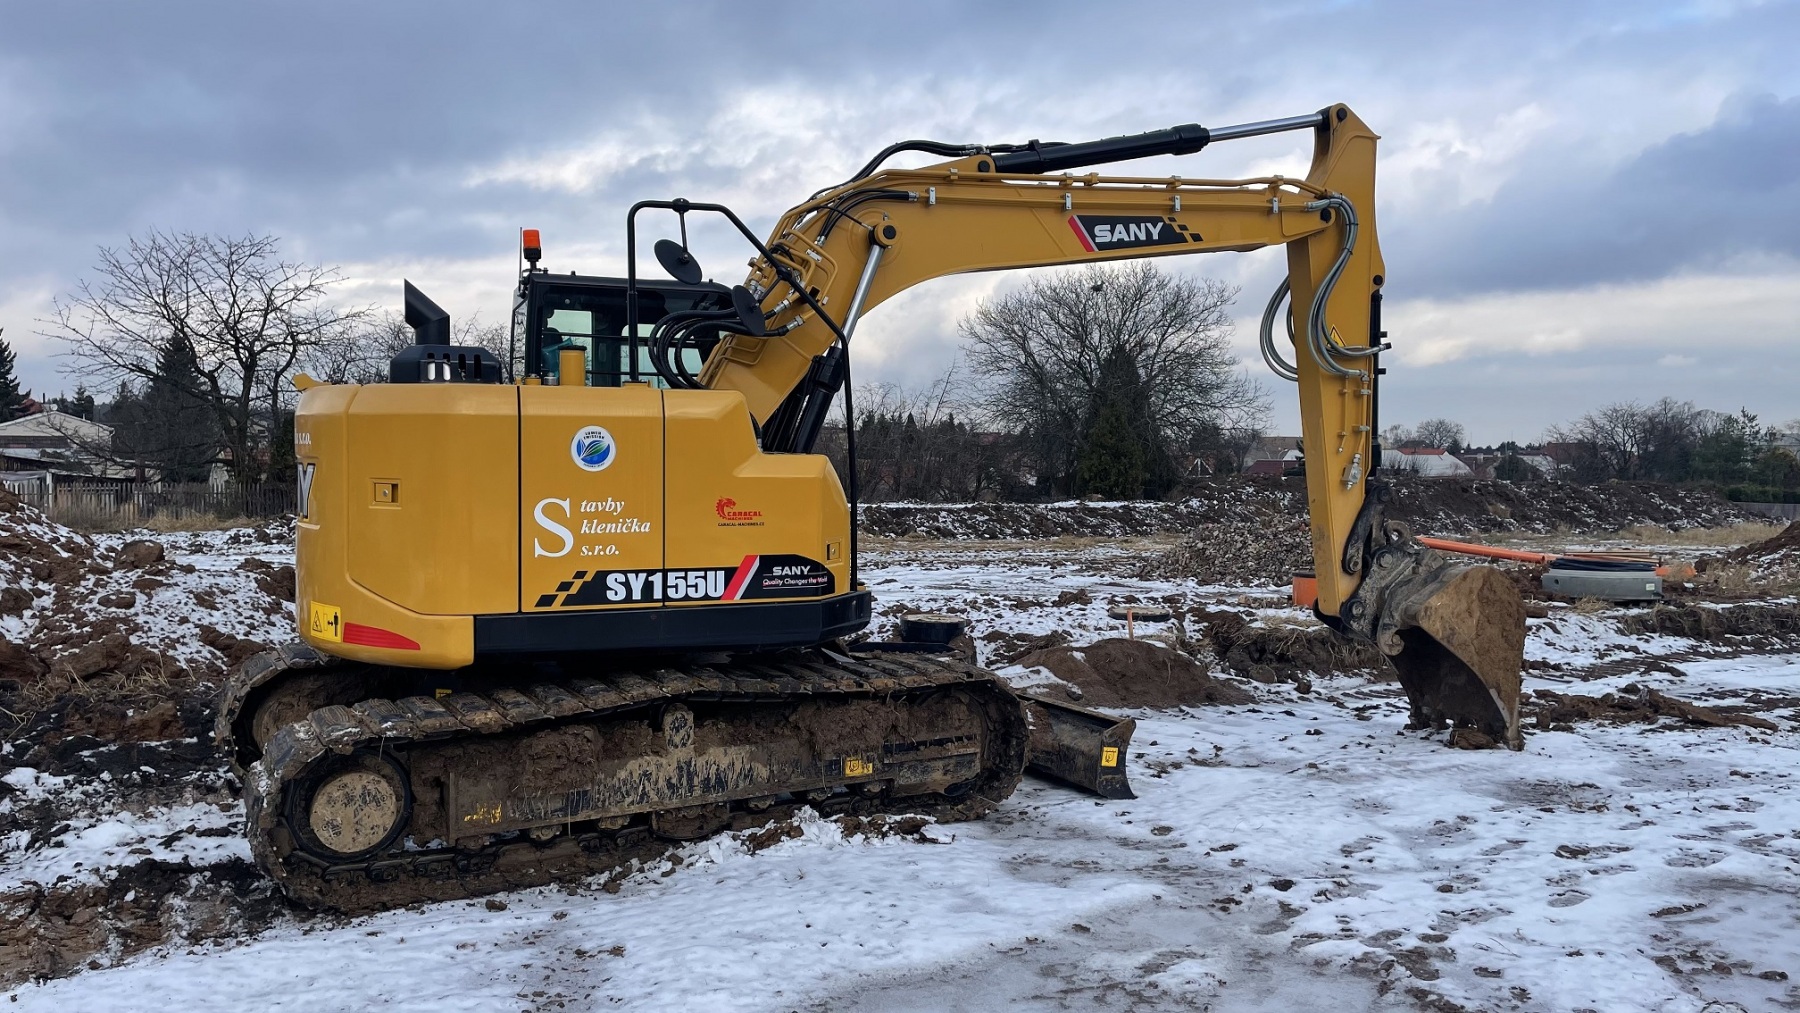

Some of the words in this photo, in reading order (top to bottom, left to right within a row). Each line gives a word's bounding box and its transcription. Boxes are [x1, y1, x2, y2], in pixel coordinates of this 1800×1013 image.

[1094, 222, 1164, 243] SANY
[580, 497, 624, 515] tavby
[580, 518, 651, 534] klenička
[580, 544, 620, 556] s.r.o.
[772, 565, 811, 576] SANY
[605, 570, 726, 601] SY155U
[762, 578, 783, 587] Quality
[784, 577, 808, 586] Changes
